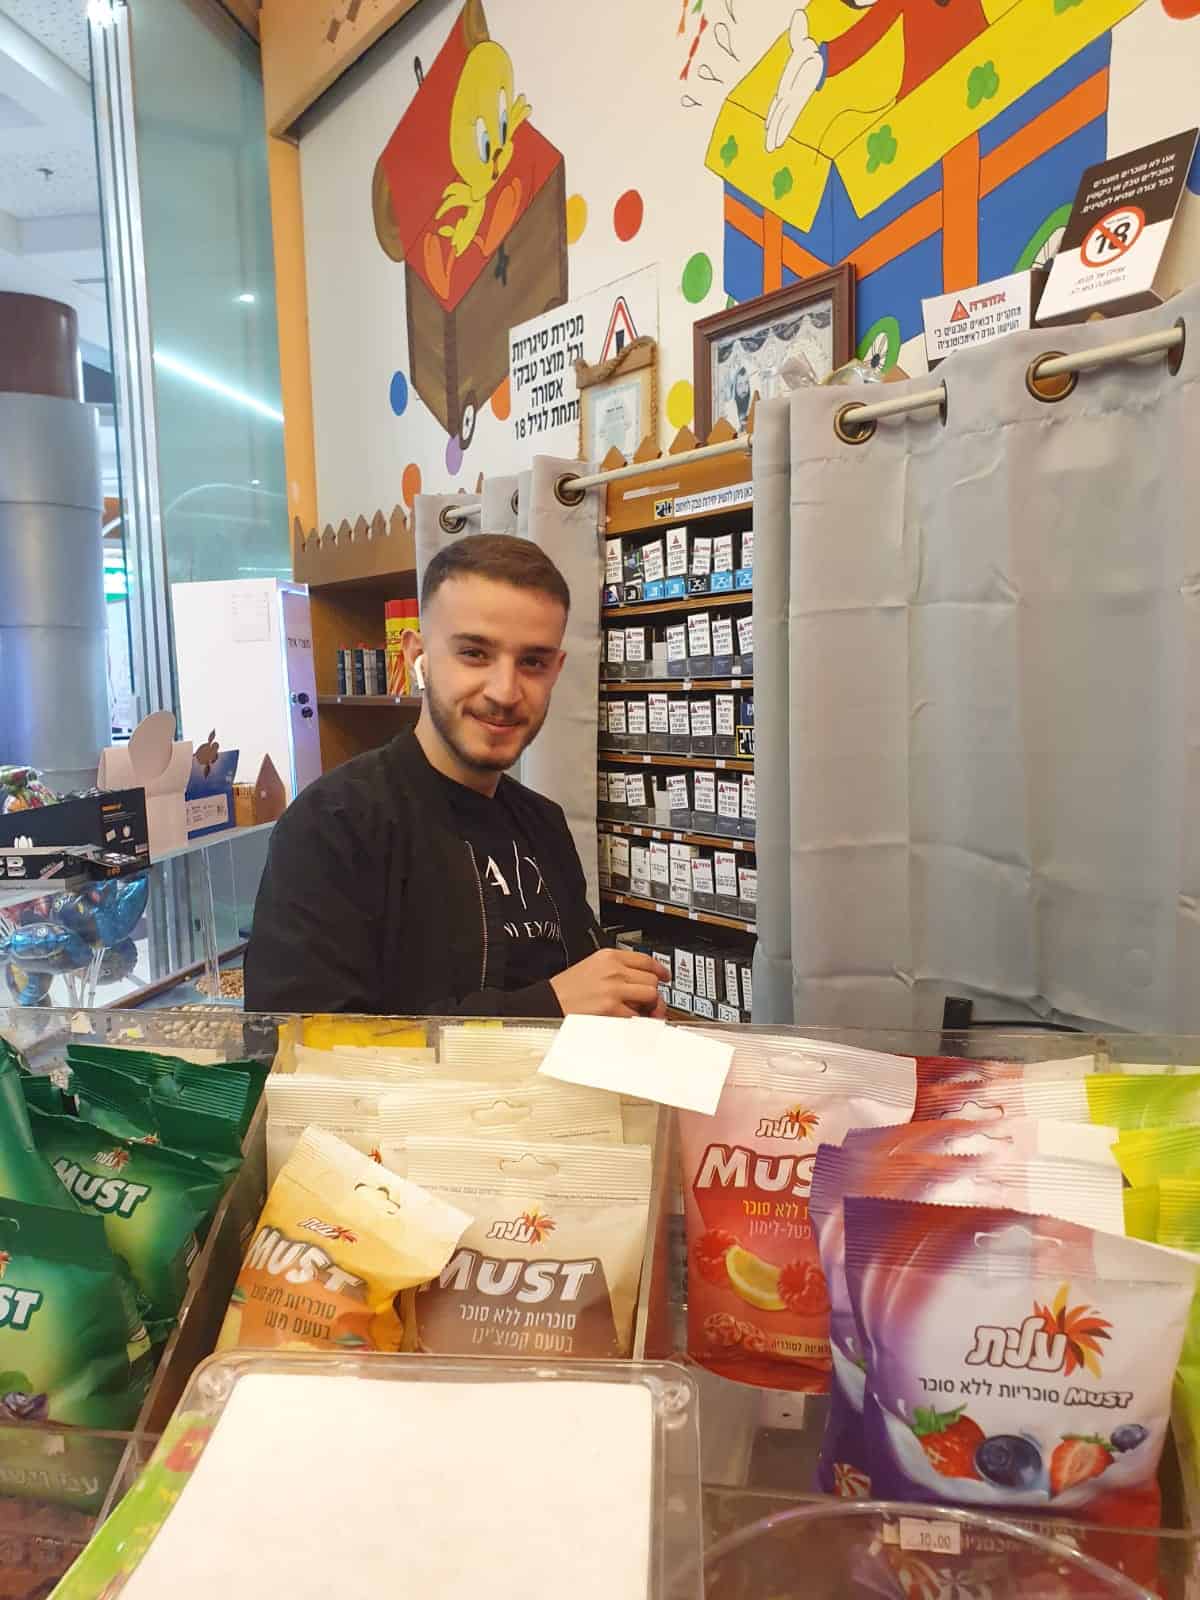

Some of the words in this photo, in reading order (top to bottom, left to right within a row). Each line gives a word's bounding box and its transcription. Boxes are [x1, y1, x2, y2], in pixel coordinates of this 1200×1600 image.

[551, 314, 584, 346] מכירת
[512, 330, 548, 363] סיגריות
[544, 351, 565, 377] מוצר
[531, 377, 564, 408] אסורה
[515, 417, 527, 440] 18
[527, 407, 549, 436] לגיל
[755, 1114, 800, 1140] עלית
[53, 1159, 149, 1213] MUST
[743, 1200, 770, 1215] סוכר
[775, 1201, 798, 1218] ללא
[486, 1217, 535, 1243] עלית
[250, 1227, 366, 1291] MUST
[436, 1249, 597, 1304] MUST
[286, 1292, 337, 1318] סוכריות
[459, 1303, 488, 1321] סוכר
[493, 1303, 521, 1321] ללא
[292, 1317, 331, 1340] בטעם
[524, 1311, 577, 1330] סוכריות
[535, 1334, 574, 1353] בטעם
[964, 1315, 1068, 1373] עלית
[918, 1376, 955, 1394] סוכר
[960, 1378, 992, 1397] ללא
[999, 1383, 1061, 1404] סוכריות
